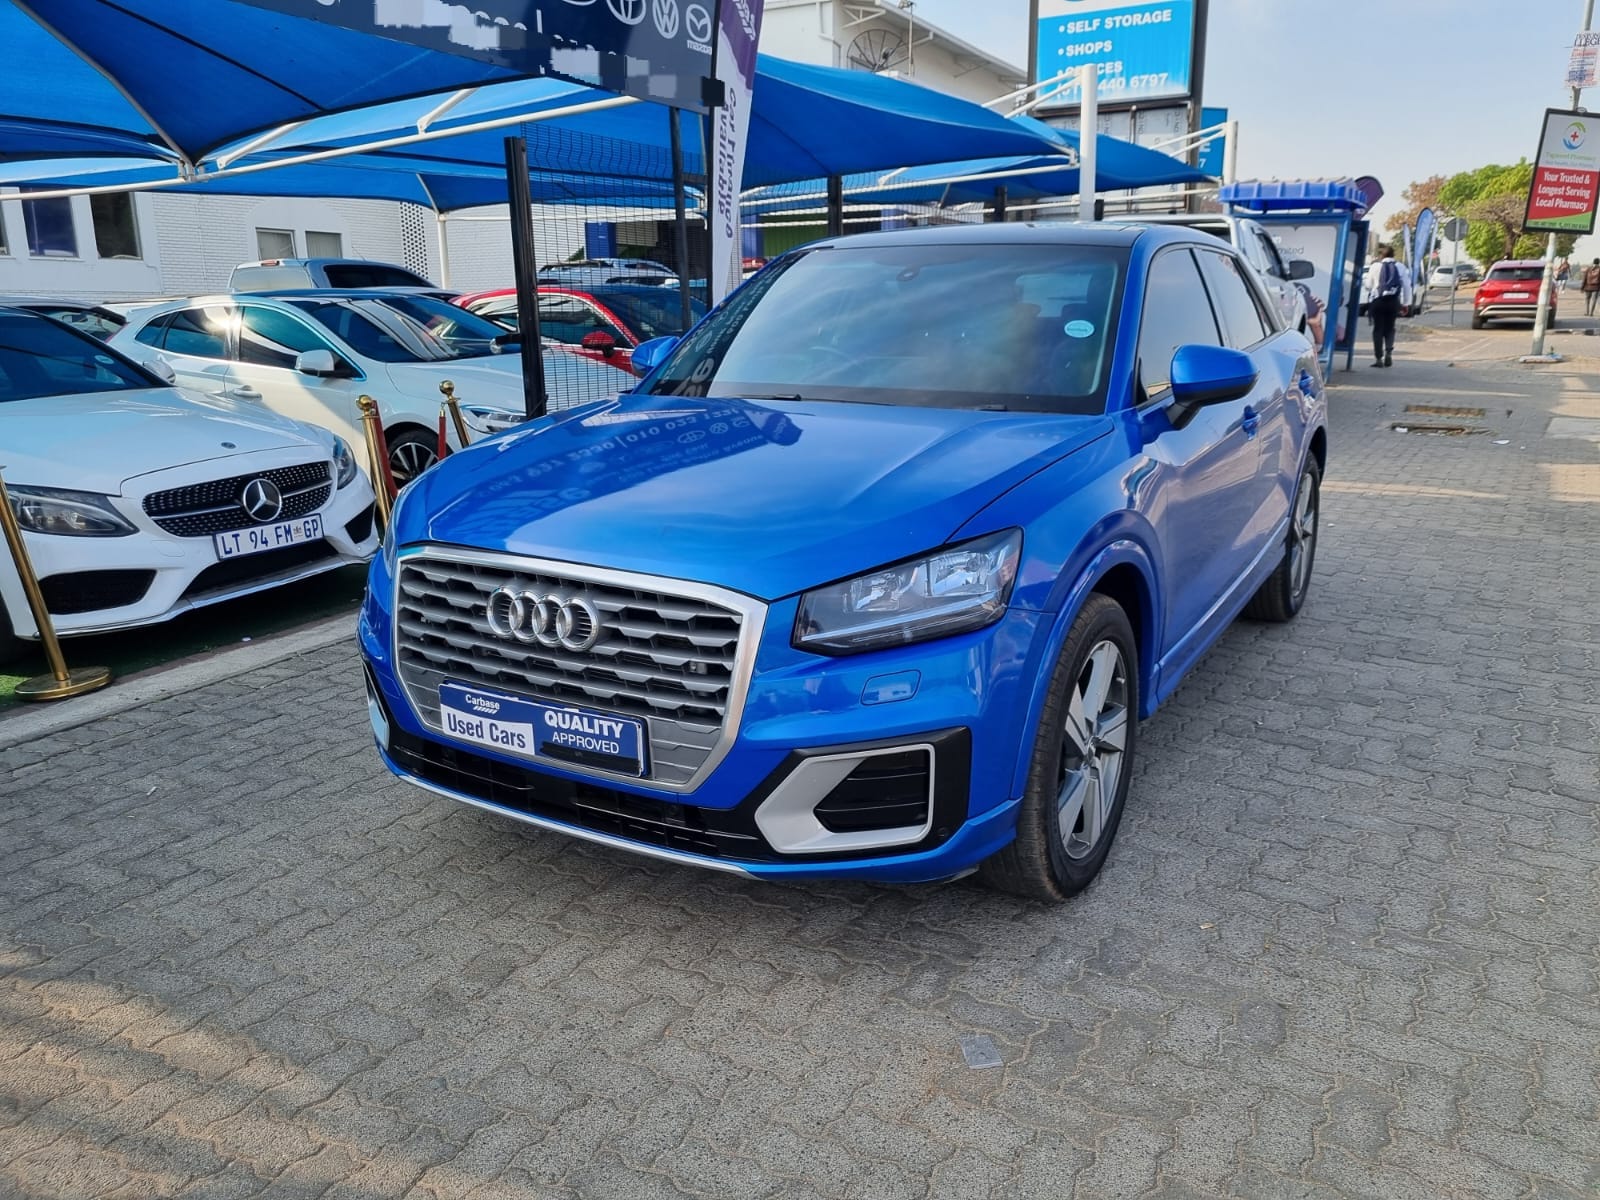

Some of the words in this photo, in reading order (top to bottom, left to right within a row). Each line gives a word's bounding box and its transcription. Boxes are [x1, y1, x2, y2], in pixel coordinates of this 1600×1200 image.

[1066, 19, 1101, 34] SELF
[1104, 9, 1172, 30] STORAGE
[1066, 40, 1113, 57] SHOPS
[1130, 72, 1169, 89] 6797
[729, 88, 737, 133] Car
[1544, 171, 1559, 182] Your
[1560, 172, 1584, 184] Trusted
[1584, 174, 1591, 185] &
[1538, 184, 1565, 197] Longest
[1565, 185, 1592, 199] Serving
[1536, 196, 1554, 207] Local
[1554, 198, 1588, 212] Pharmacy
[221, 533, 241, 555] LT
[249, 529, 269, 549] 94
[275, 523, 294, 545] FM
[303, 519, 320, 538] GP
[465, 693, 501, 710] Carbase
[447, 712, 484, 740] Used
[489, 721, 526, 749] Cars
[544, 710, 624, 739] QUALITY
[552, 731, 620, 755] APPROVED
